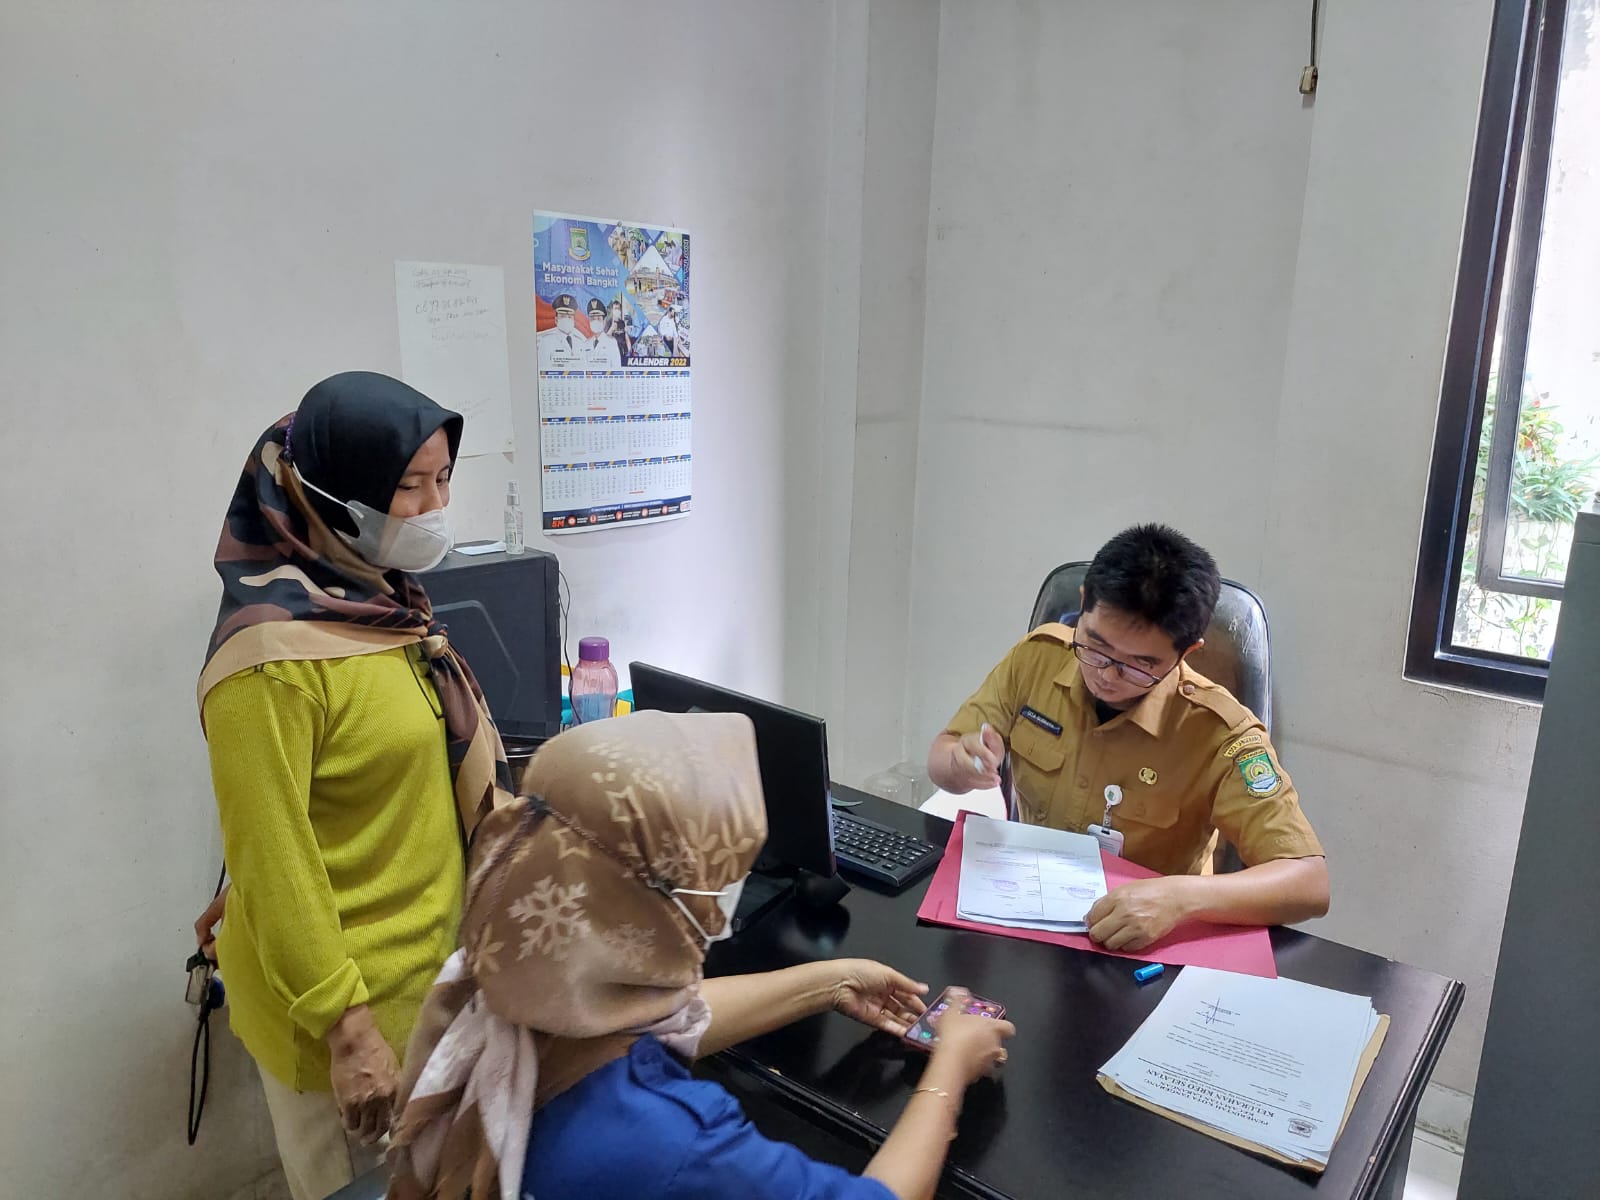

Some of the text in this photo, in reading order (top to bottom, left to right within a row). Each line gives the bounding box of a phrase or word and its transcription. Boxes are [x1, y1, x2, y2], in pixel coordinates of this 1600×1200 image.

[542, 262, 619, 276] Masyarakat Sehat
[544, 273, 618, 288] Ekonomi Bangkit
[627, 357, 687, 366] KALENDER 2022
[1146, 1068, 1185, 1087] SELATAN
[1143, 1078, 1190, 1098] TANGERANG
[1187, 1083, 1213, 1097] KREO
[1191, 1095, 1213, 1107] KOTA
[1204, 1096, 1254, 1117] KECAMATAN
[1215, 1092, 1275, 1118] KELURAHAN
[1215, 1104, 1269, 1125] PEMERINTAH
